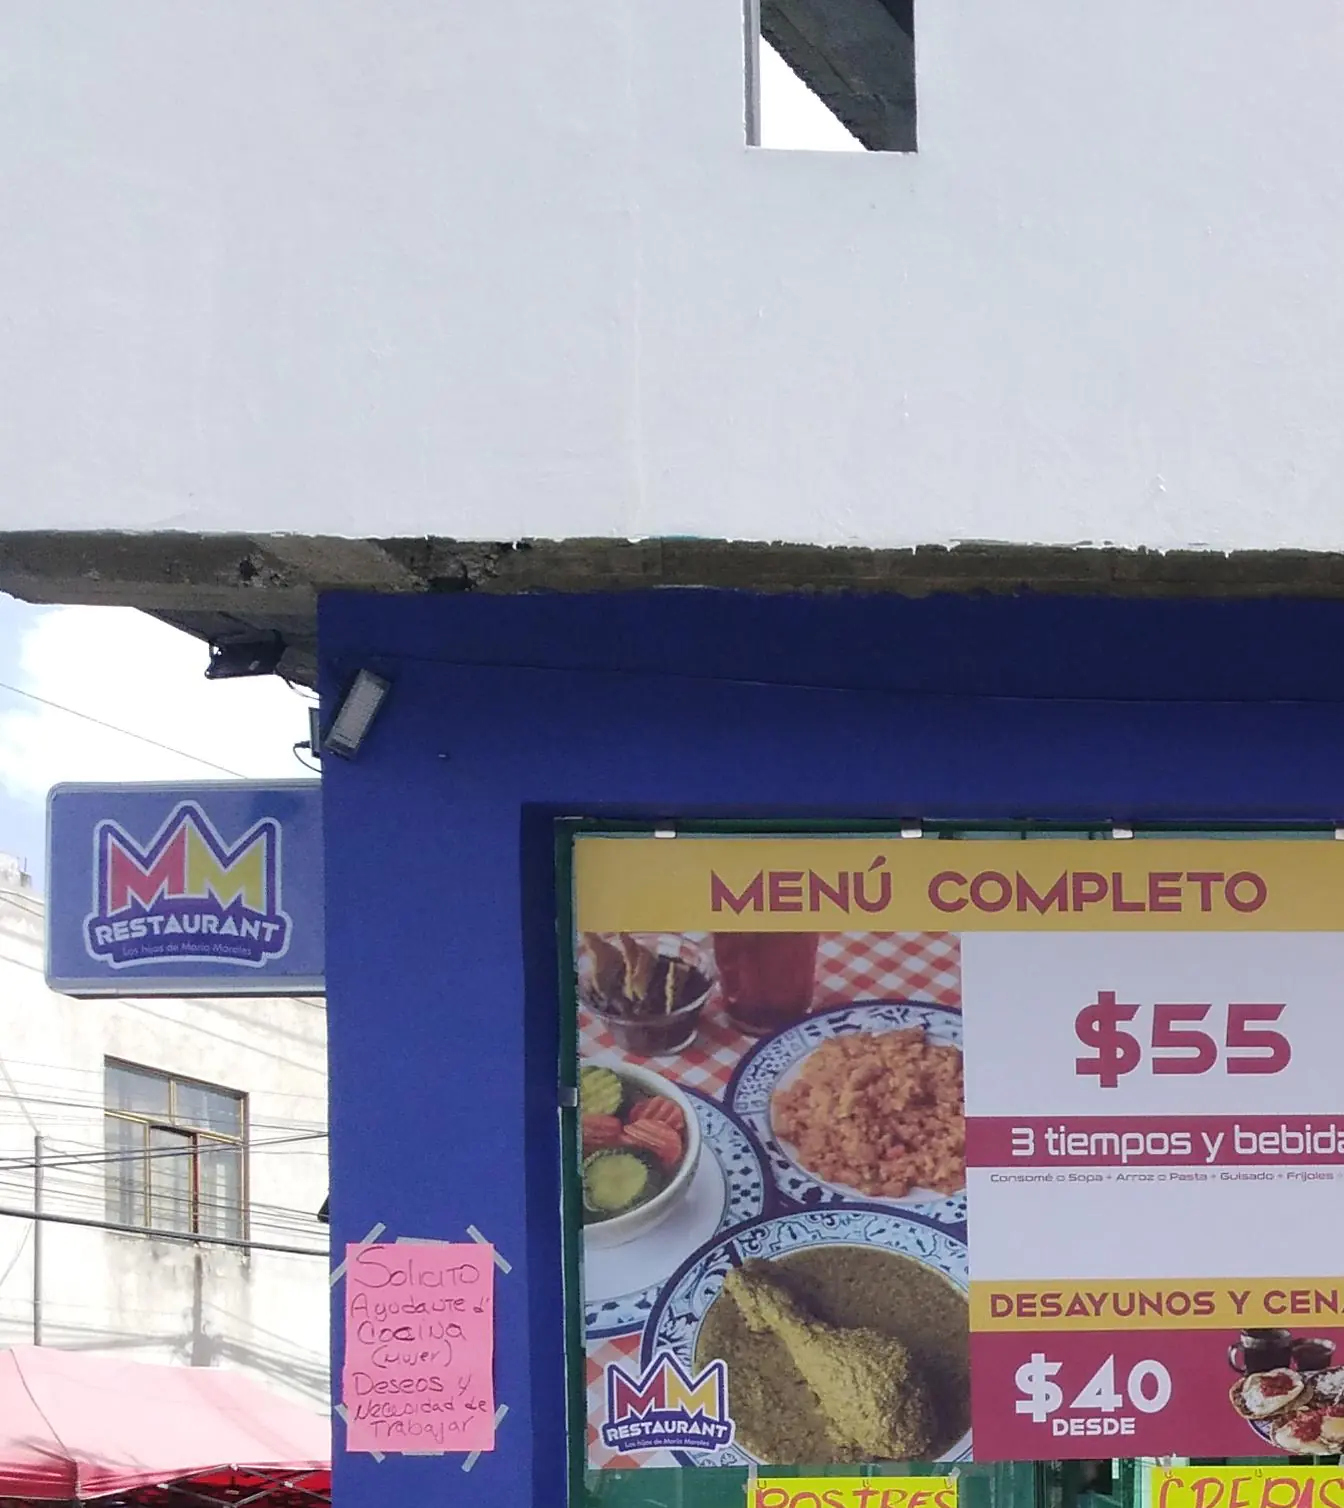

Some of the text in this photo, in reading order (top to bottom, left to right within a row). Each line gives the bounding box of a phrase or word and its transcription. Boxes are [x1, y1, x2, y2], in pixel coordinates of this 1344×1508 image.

[711, 855, 1268, 916] MENÚ COMPLETO
[95, 914, 279, 946] RESTAURANT
[1074, 990, 1292, 1089] $55
[1011, 1127, 1035, 1157] 3
[1044, 1125, 1193, 1164] tiempos
[1201, 1131, 1225, 1163] y
[1068, 1173, 1103, 1183] Sopa
[1116, 1172, 1155, 1181] Arroz
[1169, 1172, 1208, 1181] Pasta
[1220, 1171, 1275, 1181] Guisado
[1286, 1171, 1334, 1182] Frijoles
[990, 1291, 1216, 1318] DESAYUNOS
[1230, 1289, 1252, 1314] Y
[352, 1371, 444, 1396] Deseos
[1014, 1353, 1172, 1423] $40
[606, 1420, 728, 1442] RESTAURANT
[1052, 1418, 1136, 1437] DESDE
